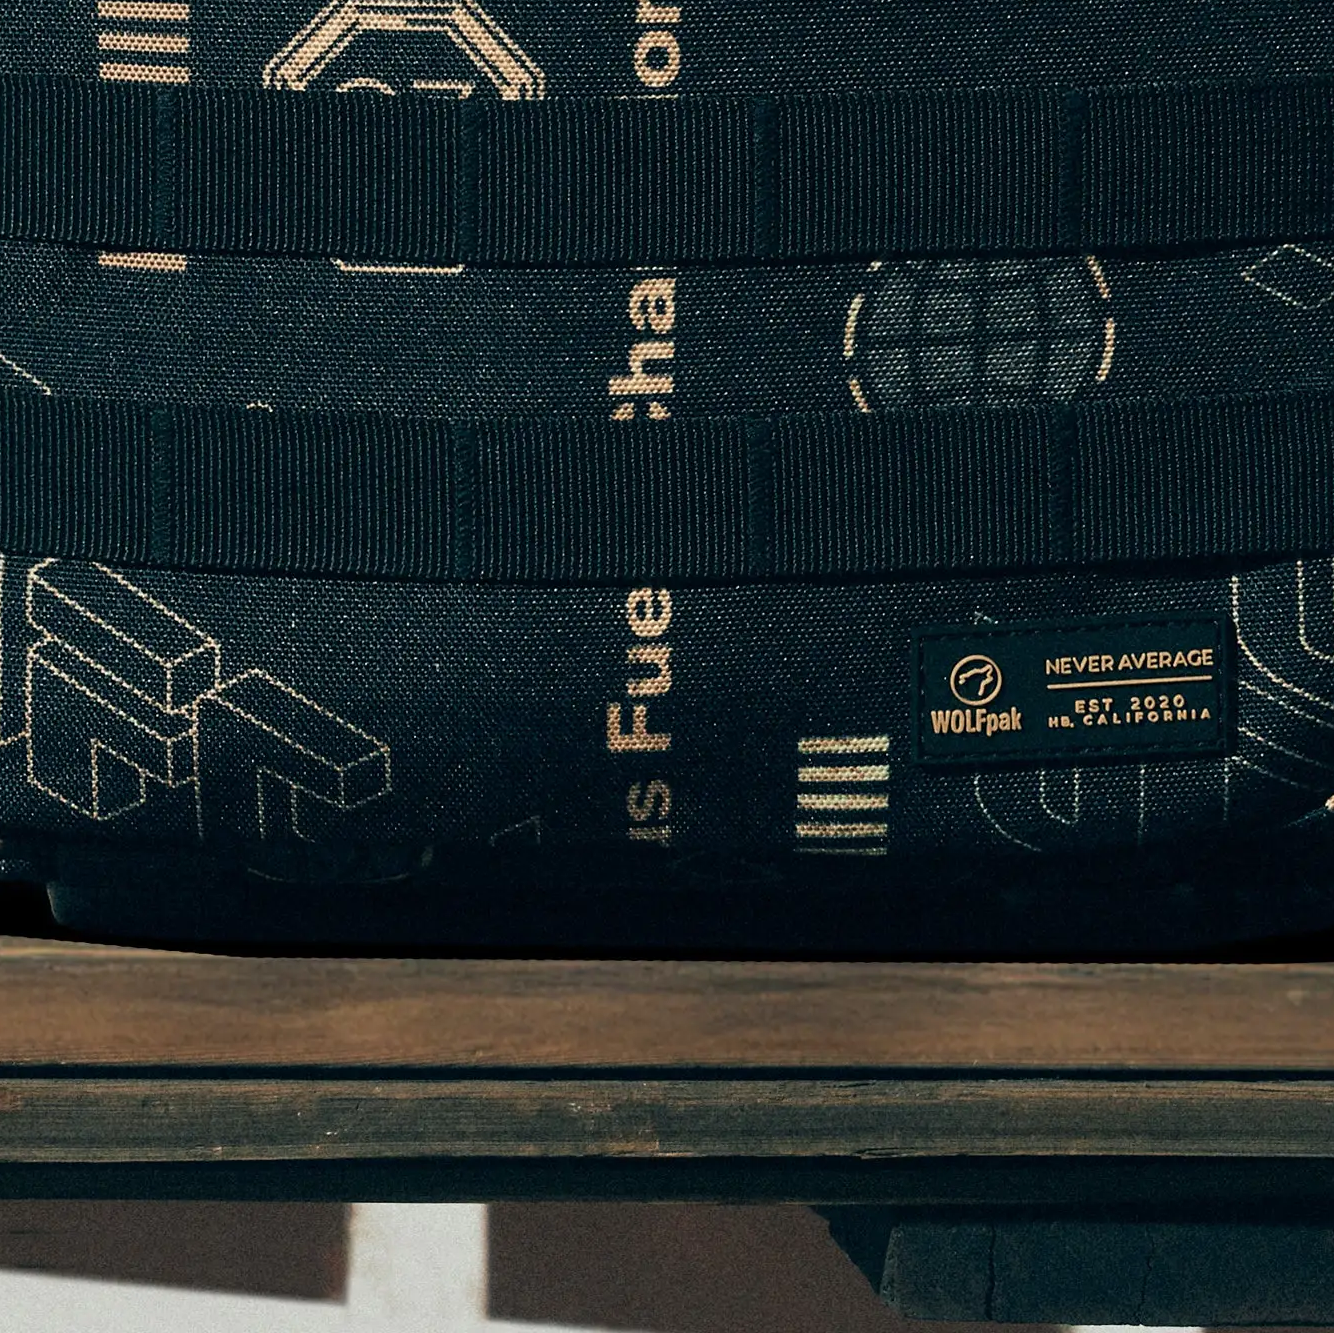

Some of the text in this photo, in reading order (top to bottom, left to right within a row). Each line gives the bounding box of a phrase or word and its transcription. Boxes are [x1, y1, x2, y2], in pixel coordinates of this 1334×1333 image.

[1046, 649, 1214, 675] NEVER AVERAGE
[1075, 694, 1185, 714] EST 2020
[930, 707, 1022, 737] WOLFpak
[1083, 708, 1212, 726] CALIFORNIA
